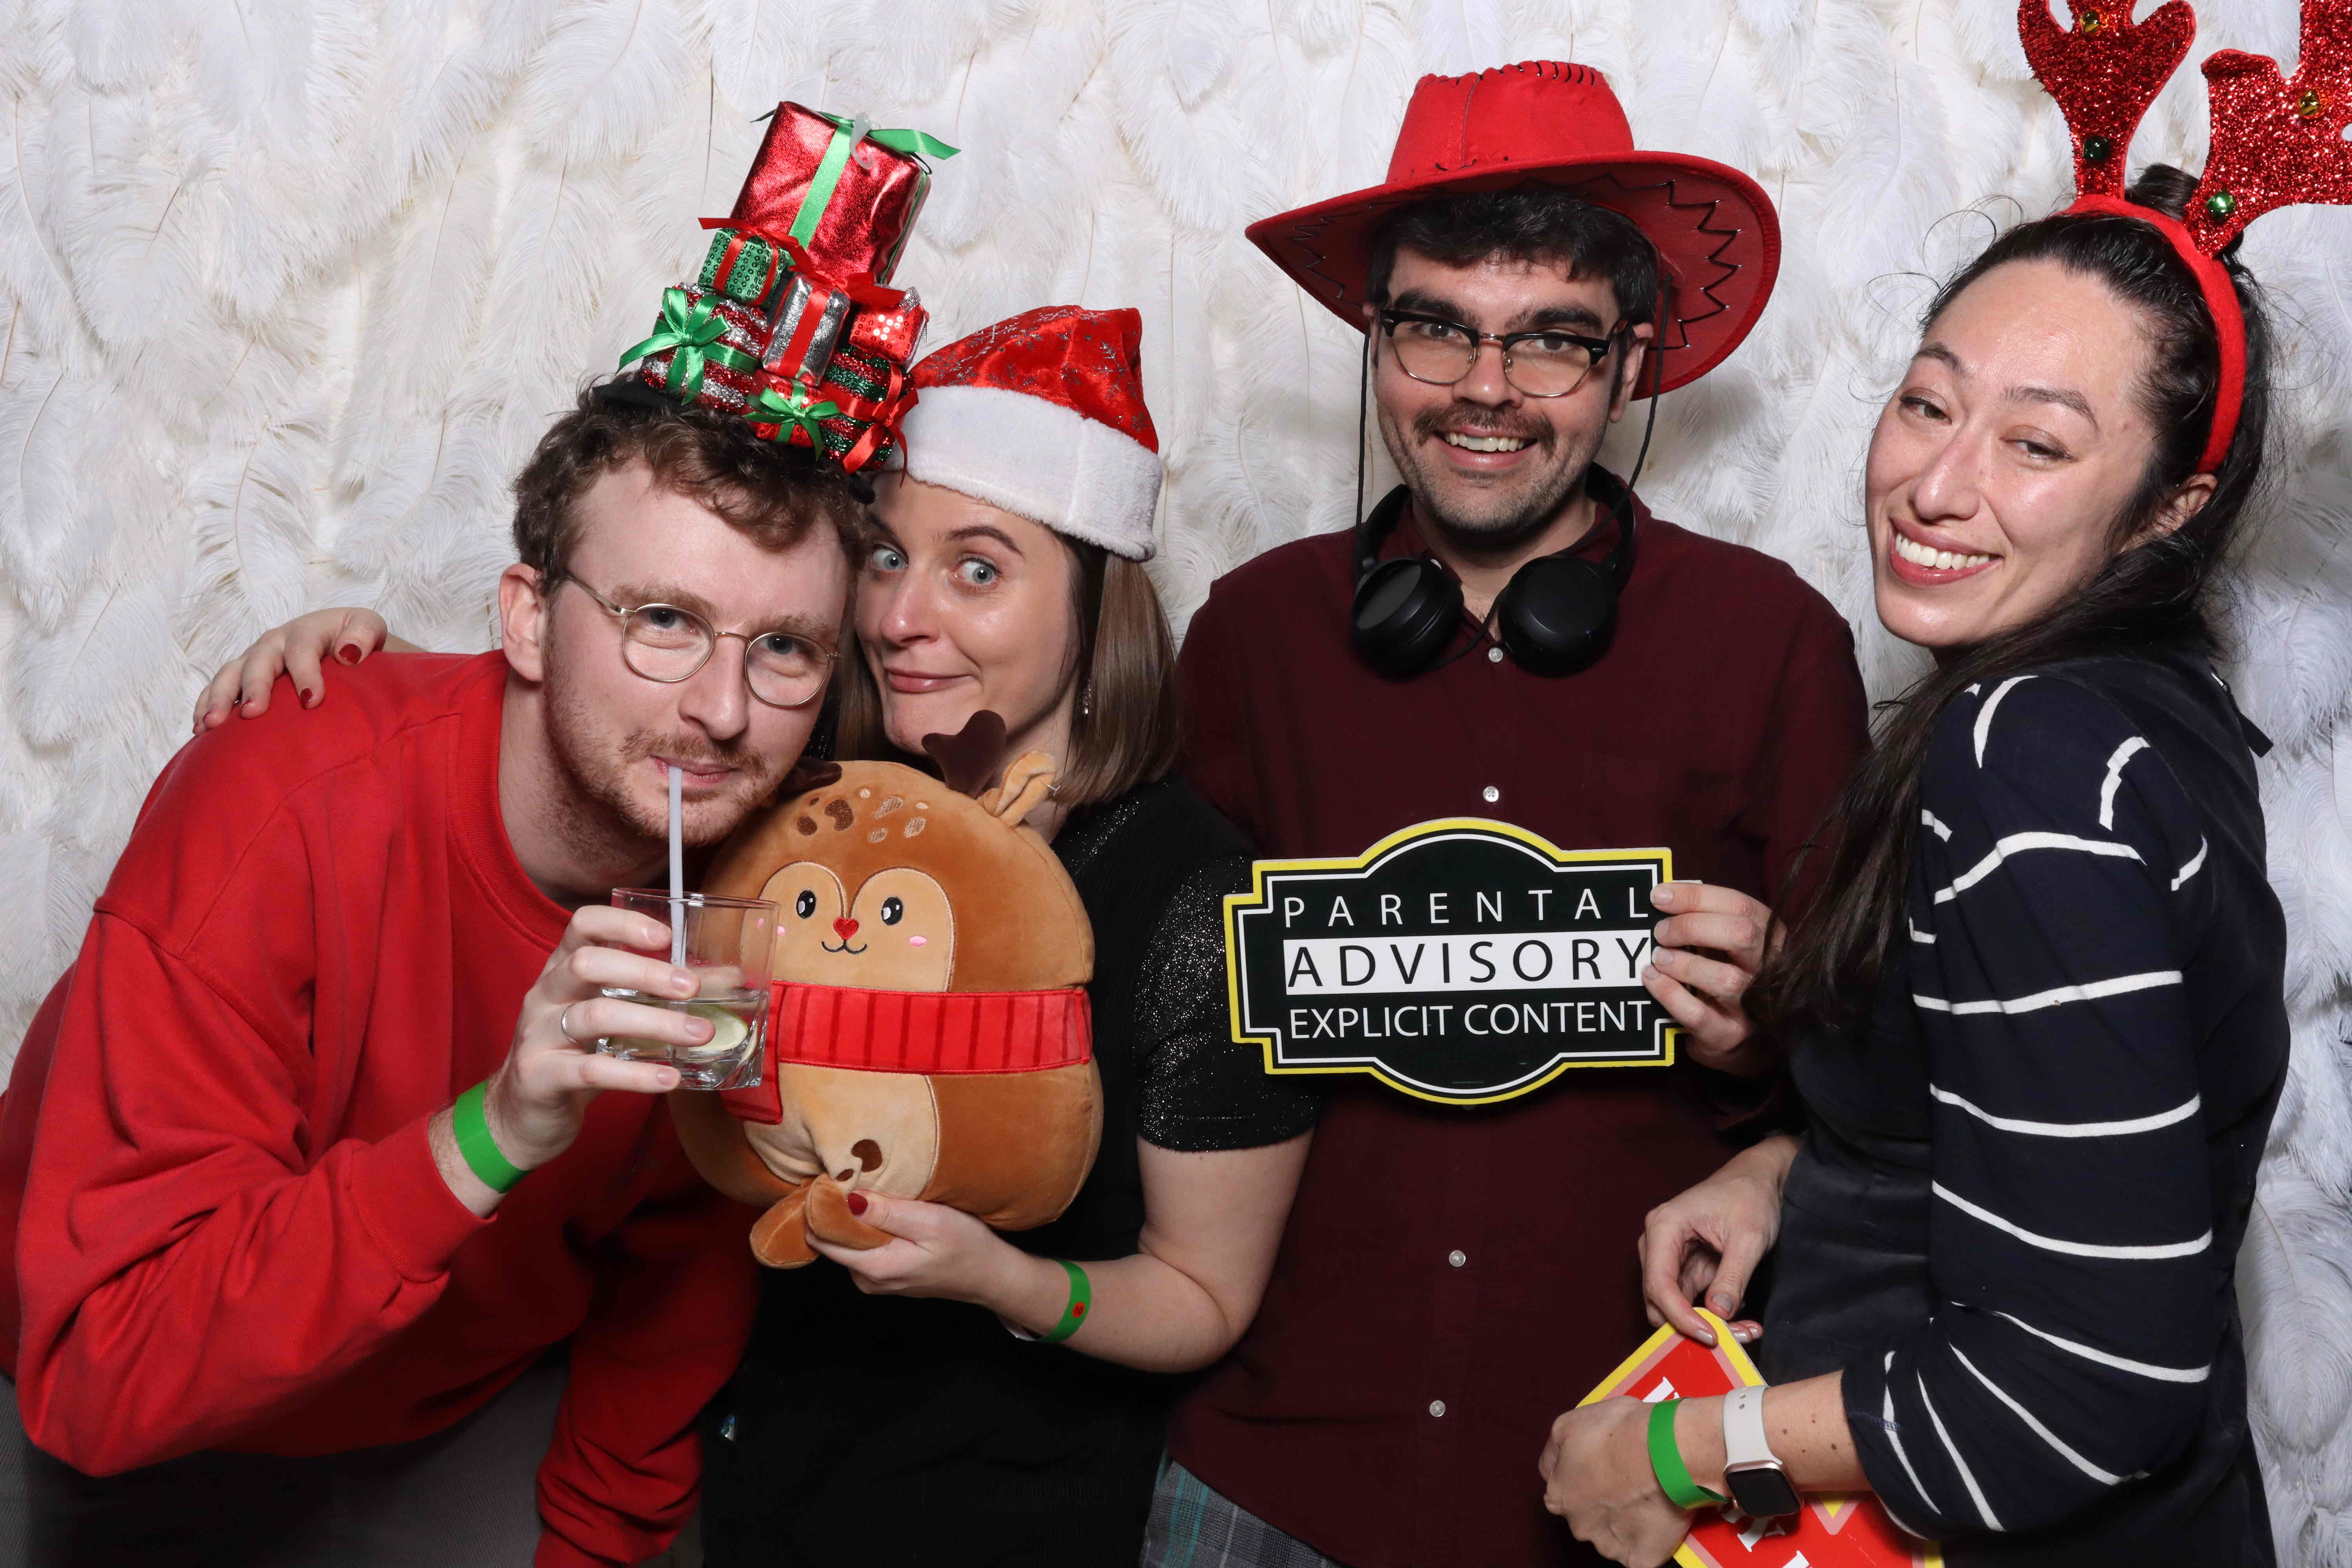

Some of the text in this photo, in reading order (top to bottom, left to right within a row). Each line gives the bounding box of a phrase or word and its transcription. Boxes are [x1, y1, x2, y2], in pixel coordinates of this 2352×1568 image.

[1284, 887, 1649, 927] PARENTAL
[1287, 937, 1650, 987] ADVISORY
[1290, 1000, 1651, 1039] EXPLICIT CONTENT
